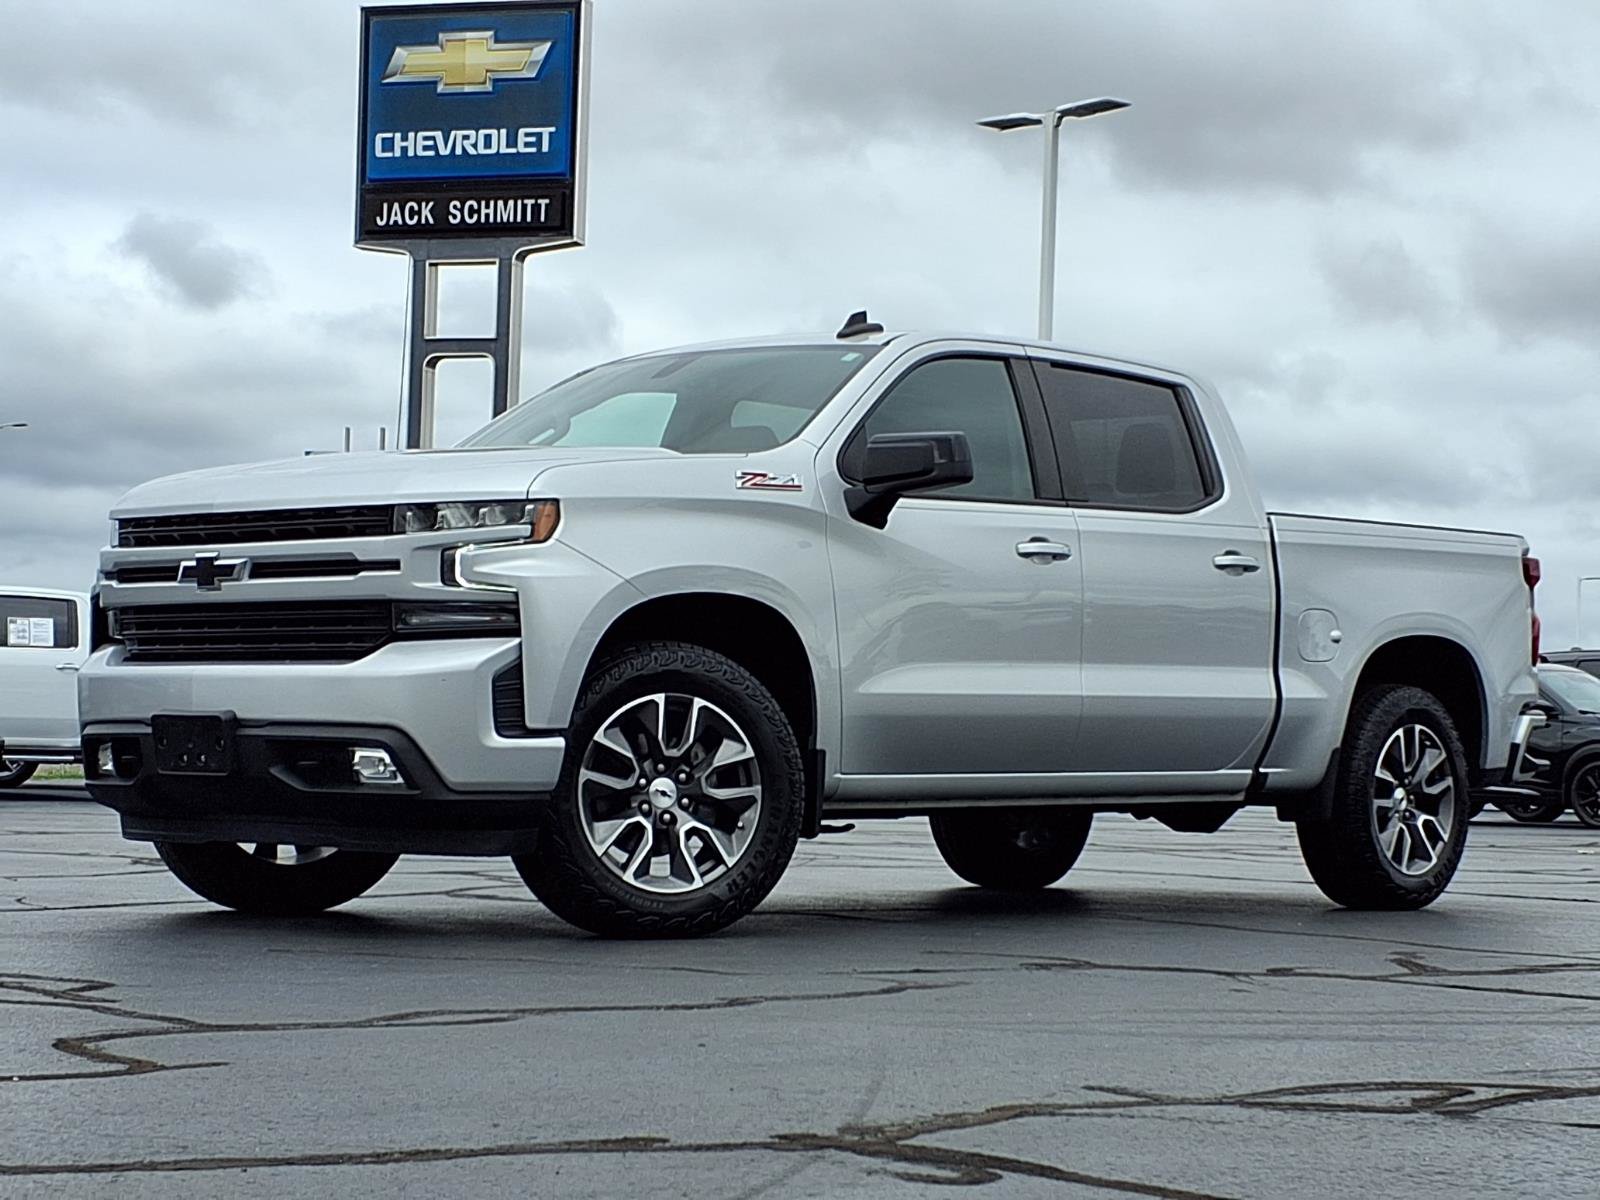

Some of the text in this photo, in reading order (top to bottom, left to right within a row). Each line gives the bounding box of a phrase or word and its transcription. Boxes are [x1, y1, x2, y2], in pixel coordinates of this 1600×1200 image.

[375, 127, 556, 157] CHEVROLET
[376, 199, 550, 226] JACK SCHMITT
